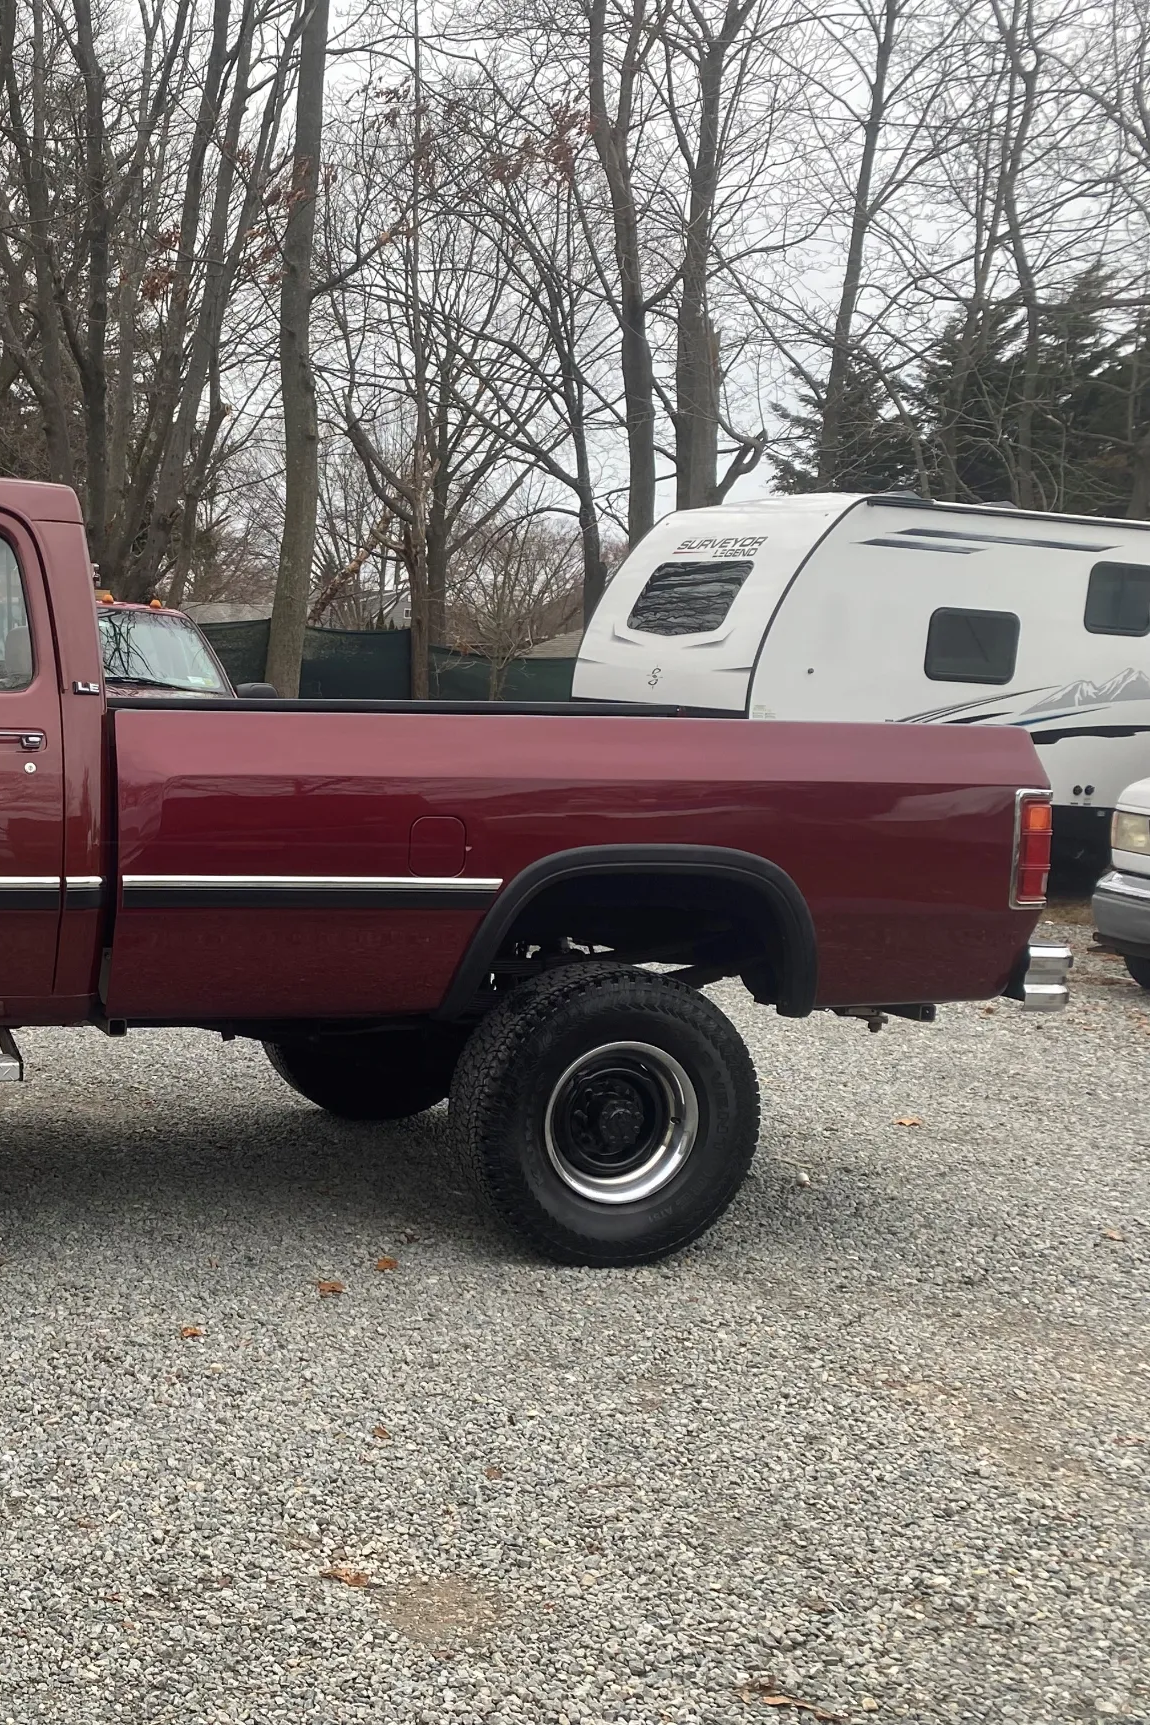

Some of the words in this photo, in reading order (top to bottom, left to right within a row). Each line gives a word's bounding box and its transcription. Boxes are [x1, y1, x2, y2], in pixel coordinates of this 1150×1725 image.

[677, 536, 768, 550] SURVEYOR
[712, 548, 758, 558] LEGEND
[78, 681, 100, 693] LE
